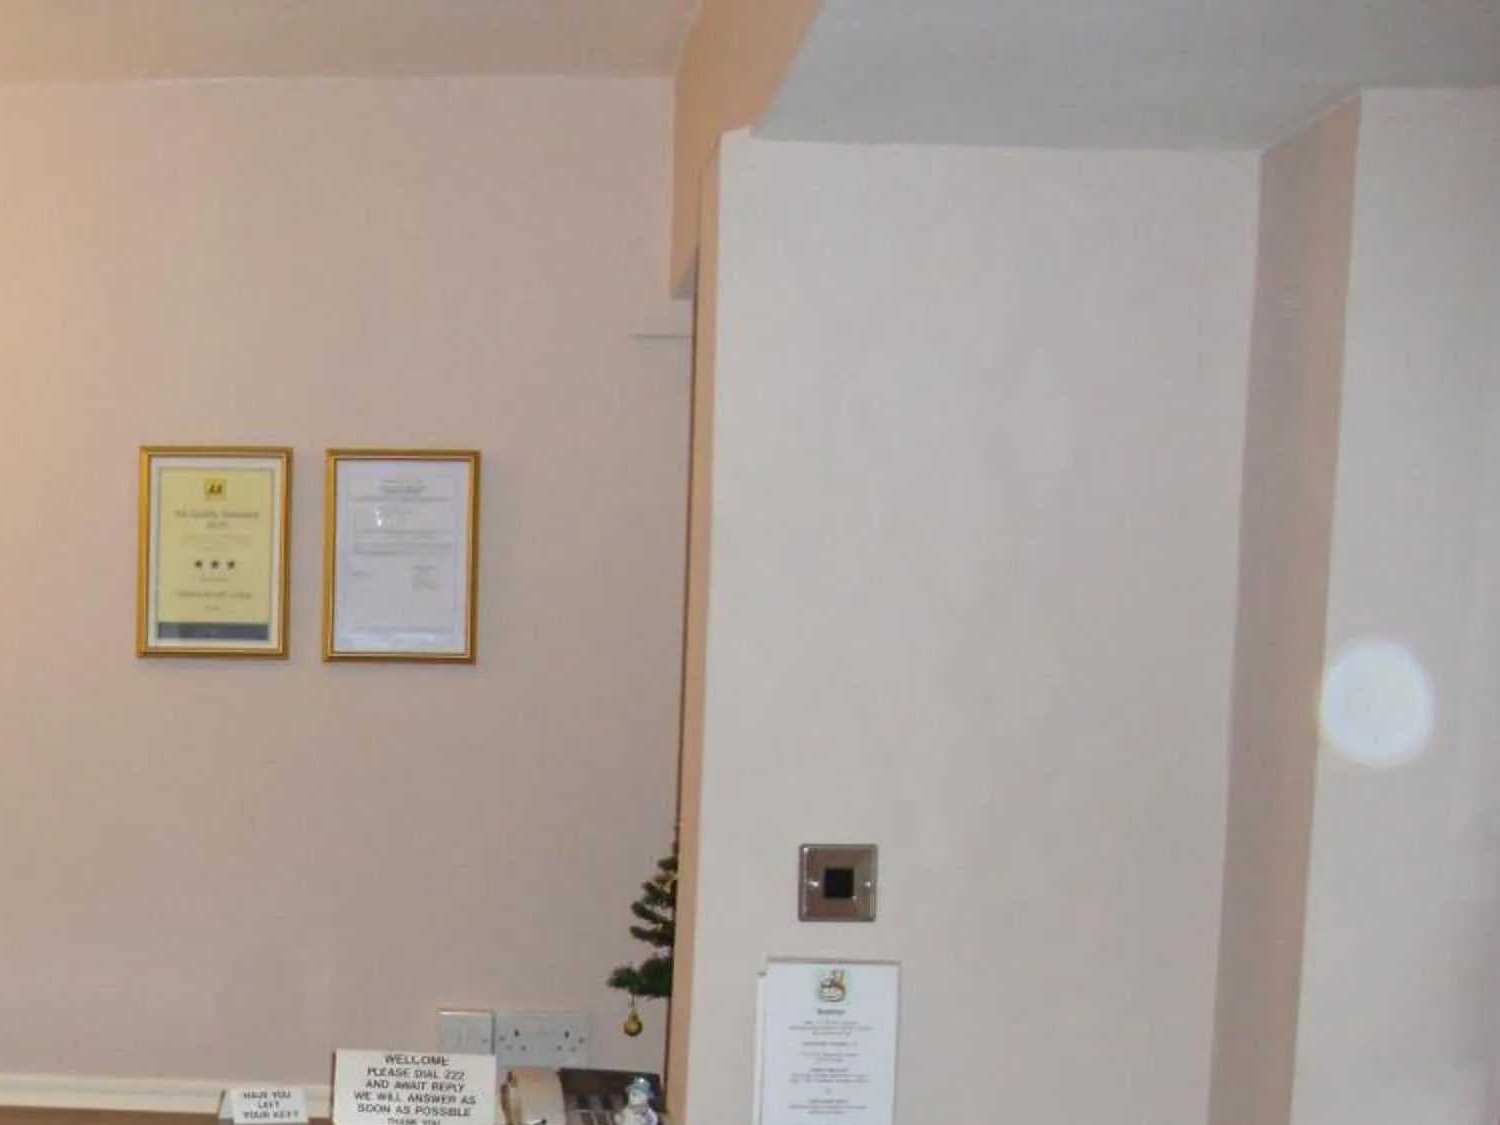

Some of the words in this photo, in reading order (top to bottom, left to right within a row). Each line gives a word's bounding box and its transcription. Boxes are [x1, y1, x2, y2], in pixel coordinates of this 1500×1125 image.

[385, 1053, 450, 1067] WELCOME
[367, 1067, 411, 1079] PLEASE
[413, 1069, 442, 1080] DIAL
[444, 1070, 465, 1081] 222
[365, 1079, 390, 1089] AND
[393, 1081, 427, 1091] AWAIT
[431, 1082, 466, 1093] REPLY
[271, 1091, 291, 1099] YOU
[354, 1091, 373, 1101] WE
[376, 1092, 403, 1102] WILL
[407, 1094, 457, 1104] ANSWER
[459, 1095, 477, 1105] AS
[356, 1103, 391, 1114] SOON
[395, 1105, 411, 1116] AS
[414, 1106, 471, 1118] POSSIBLE
